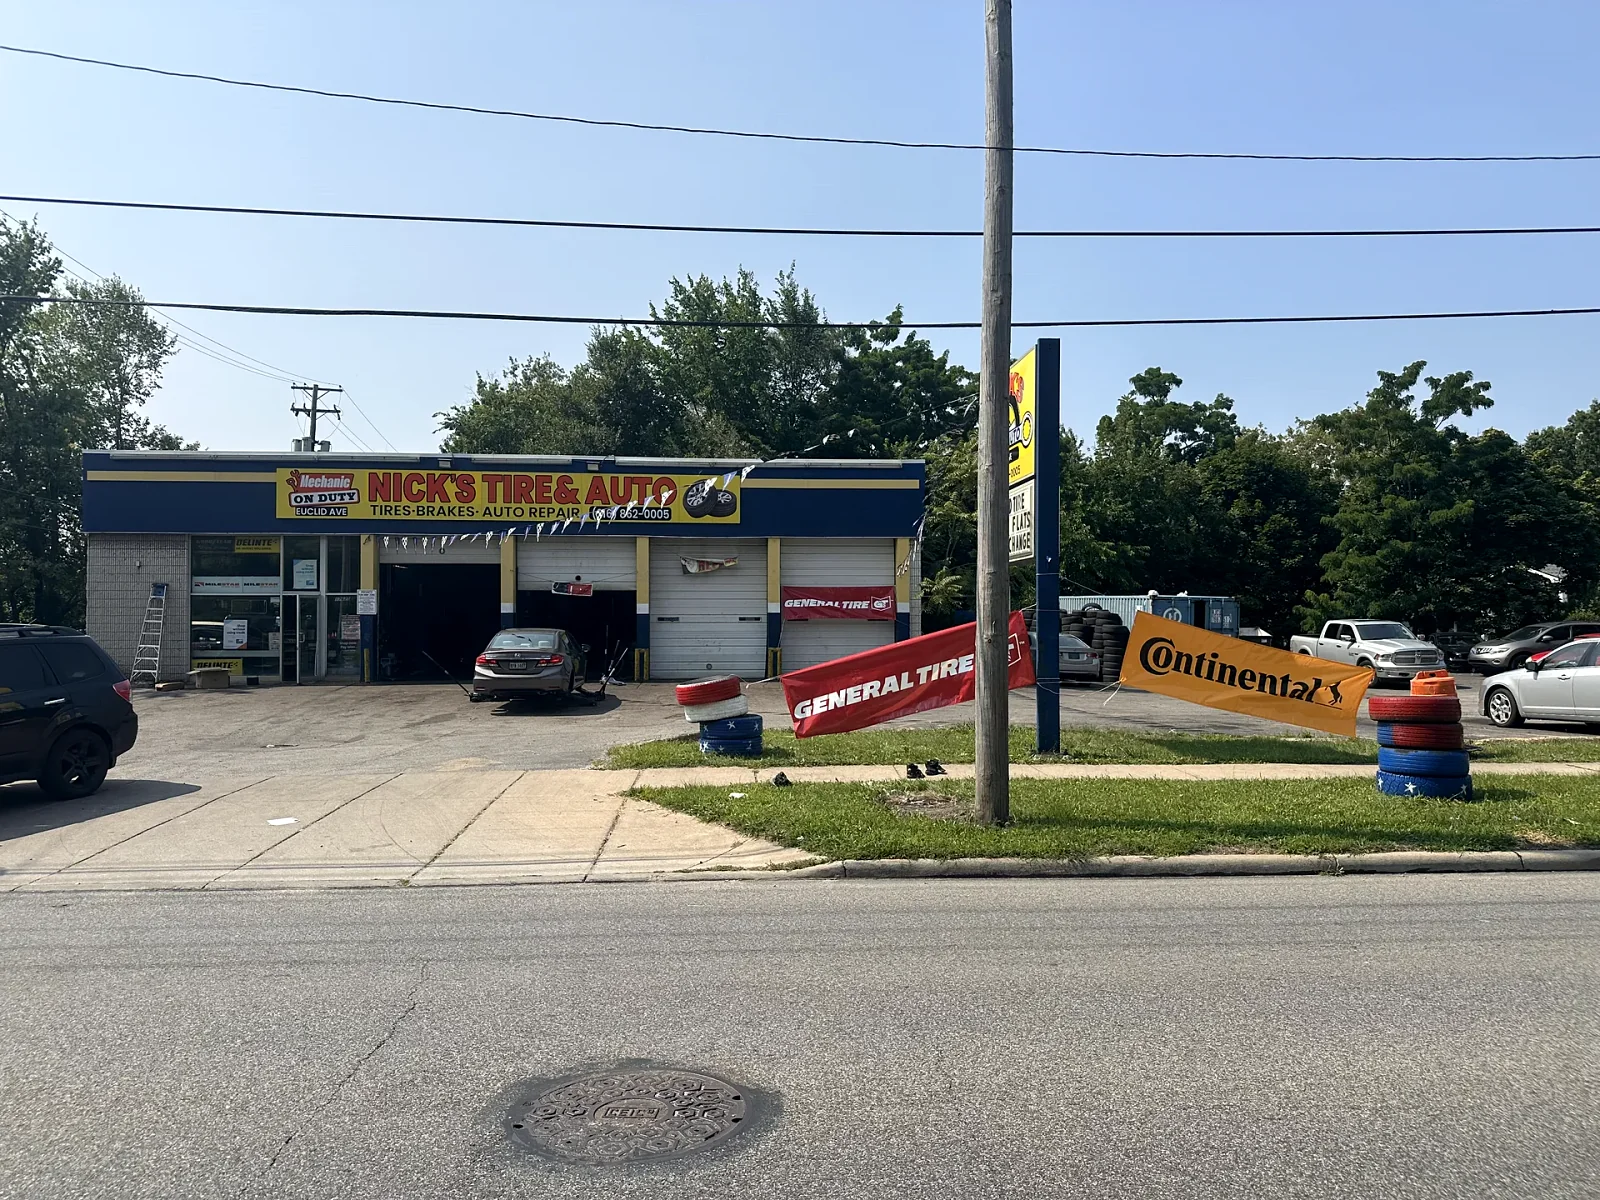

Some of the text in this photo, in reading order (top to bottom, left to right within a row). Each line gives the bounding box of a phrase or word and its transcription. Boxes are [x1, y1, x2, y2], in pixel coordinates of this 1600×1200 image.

[300, 475, 351, 488] Mechanic
[368, 472, 476, 503] NICK'S
[585, 476, 677, 506] AUTO
[294, 492, 356, 504] ON DUTY
[296, 507, 347, 516] EUCLID AVE
[482, 507, 525, 517] AUTO
[529, 507, 580, 518] REPAIR
[1012, 511, 1031, 532] FLATS
[236, 538, 273, 546] DELINTE
[784, 599, 871, 609] GENERAL TIRE
[1139, 636, 1322, 704] Continental
[794, 653, 975, 719] GENERAL TIRE
